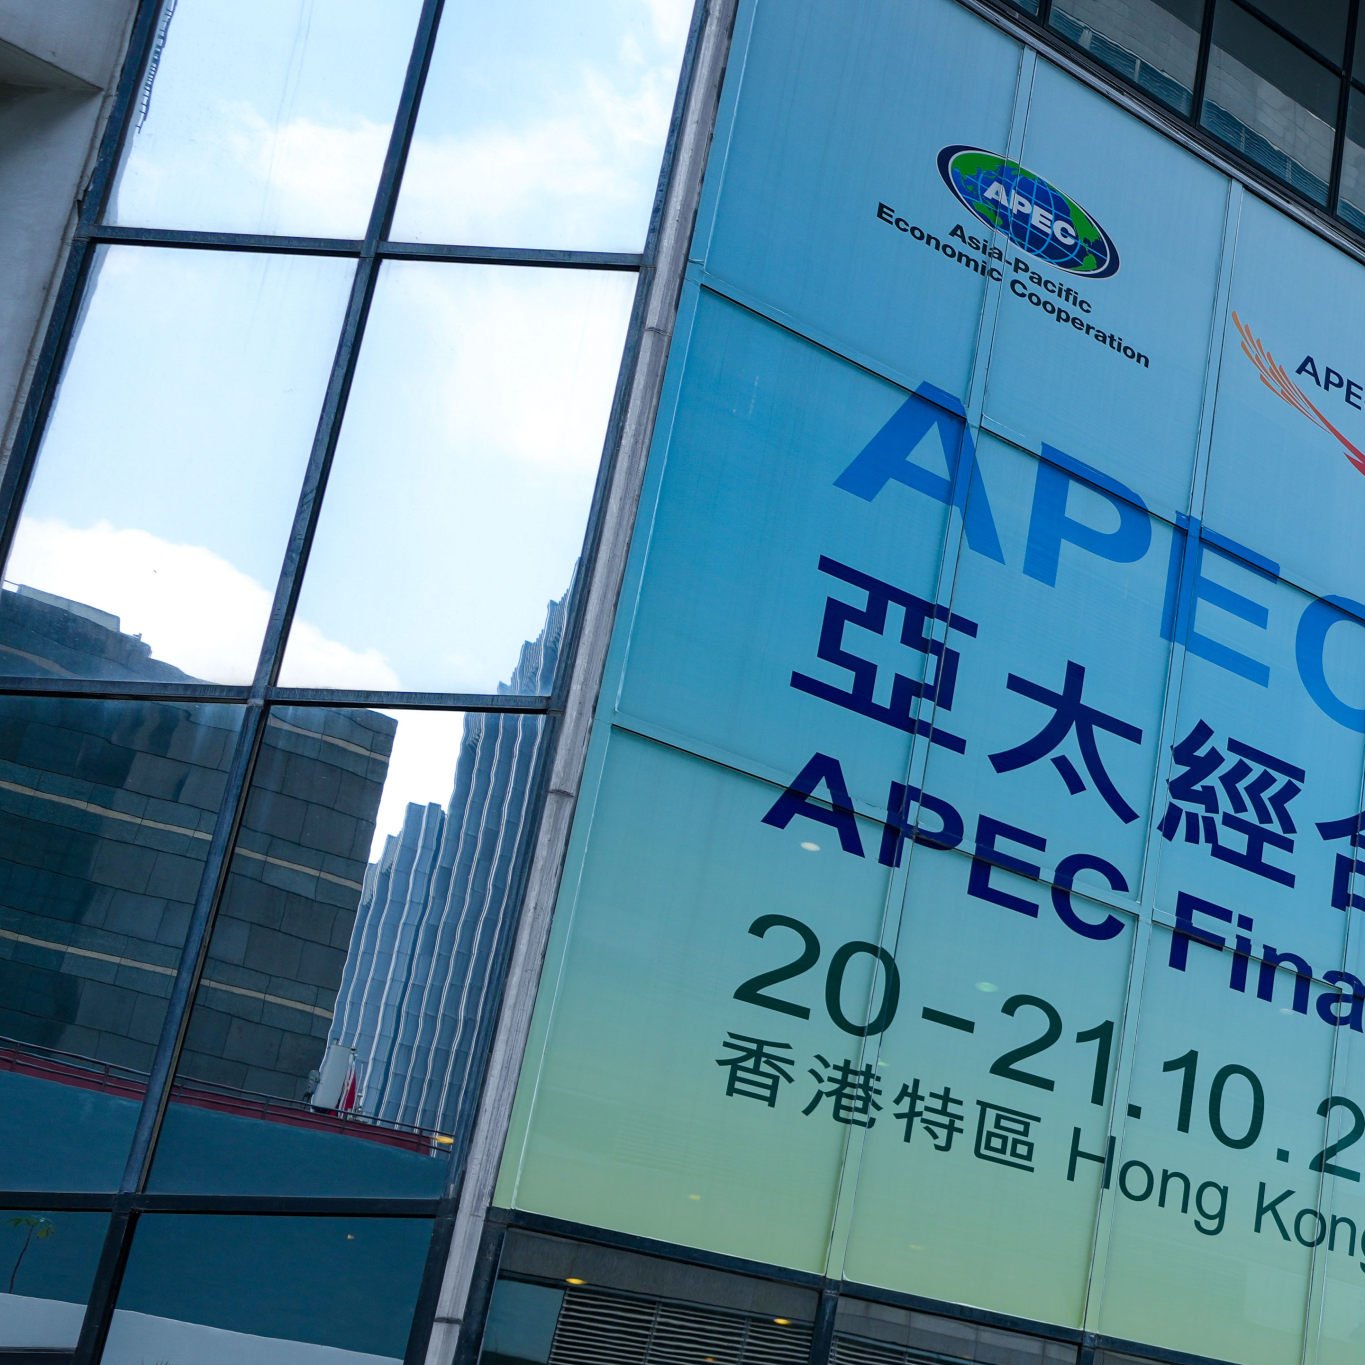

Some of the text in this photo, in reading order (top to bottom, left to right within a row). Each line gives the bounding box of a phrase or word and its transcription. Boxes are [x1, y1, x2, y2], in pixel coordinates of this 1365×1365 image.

[876, 201, 1149, 368] Economic Cooperation
[948, 223, 1093, 314] Asia-Pacific
[984, 181, 1076, 246] APEC
[760, 752, 1130, 941] APEC
[716, 1032, 1042, 1173] 香港特區
[1066, 1127, 1229, 1237] Hong
